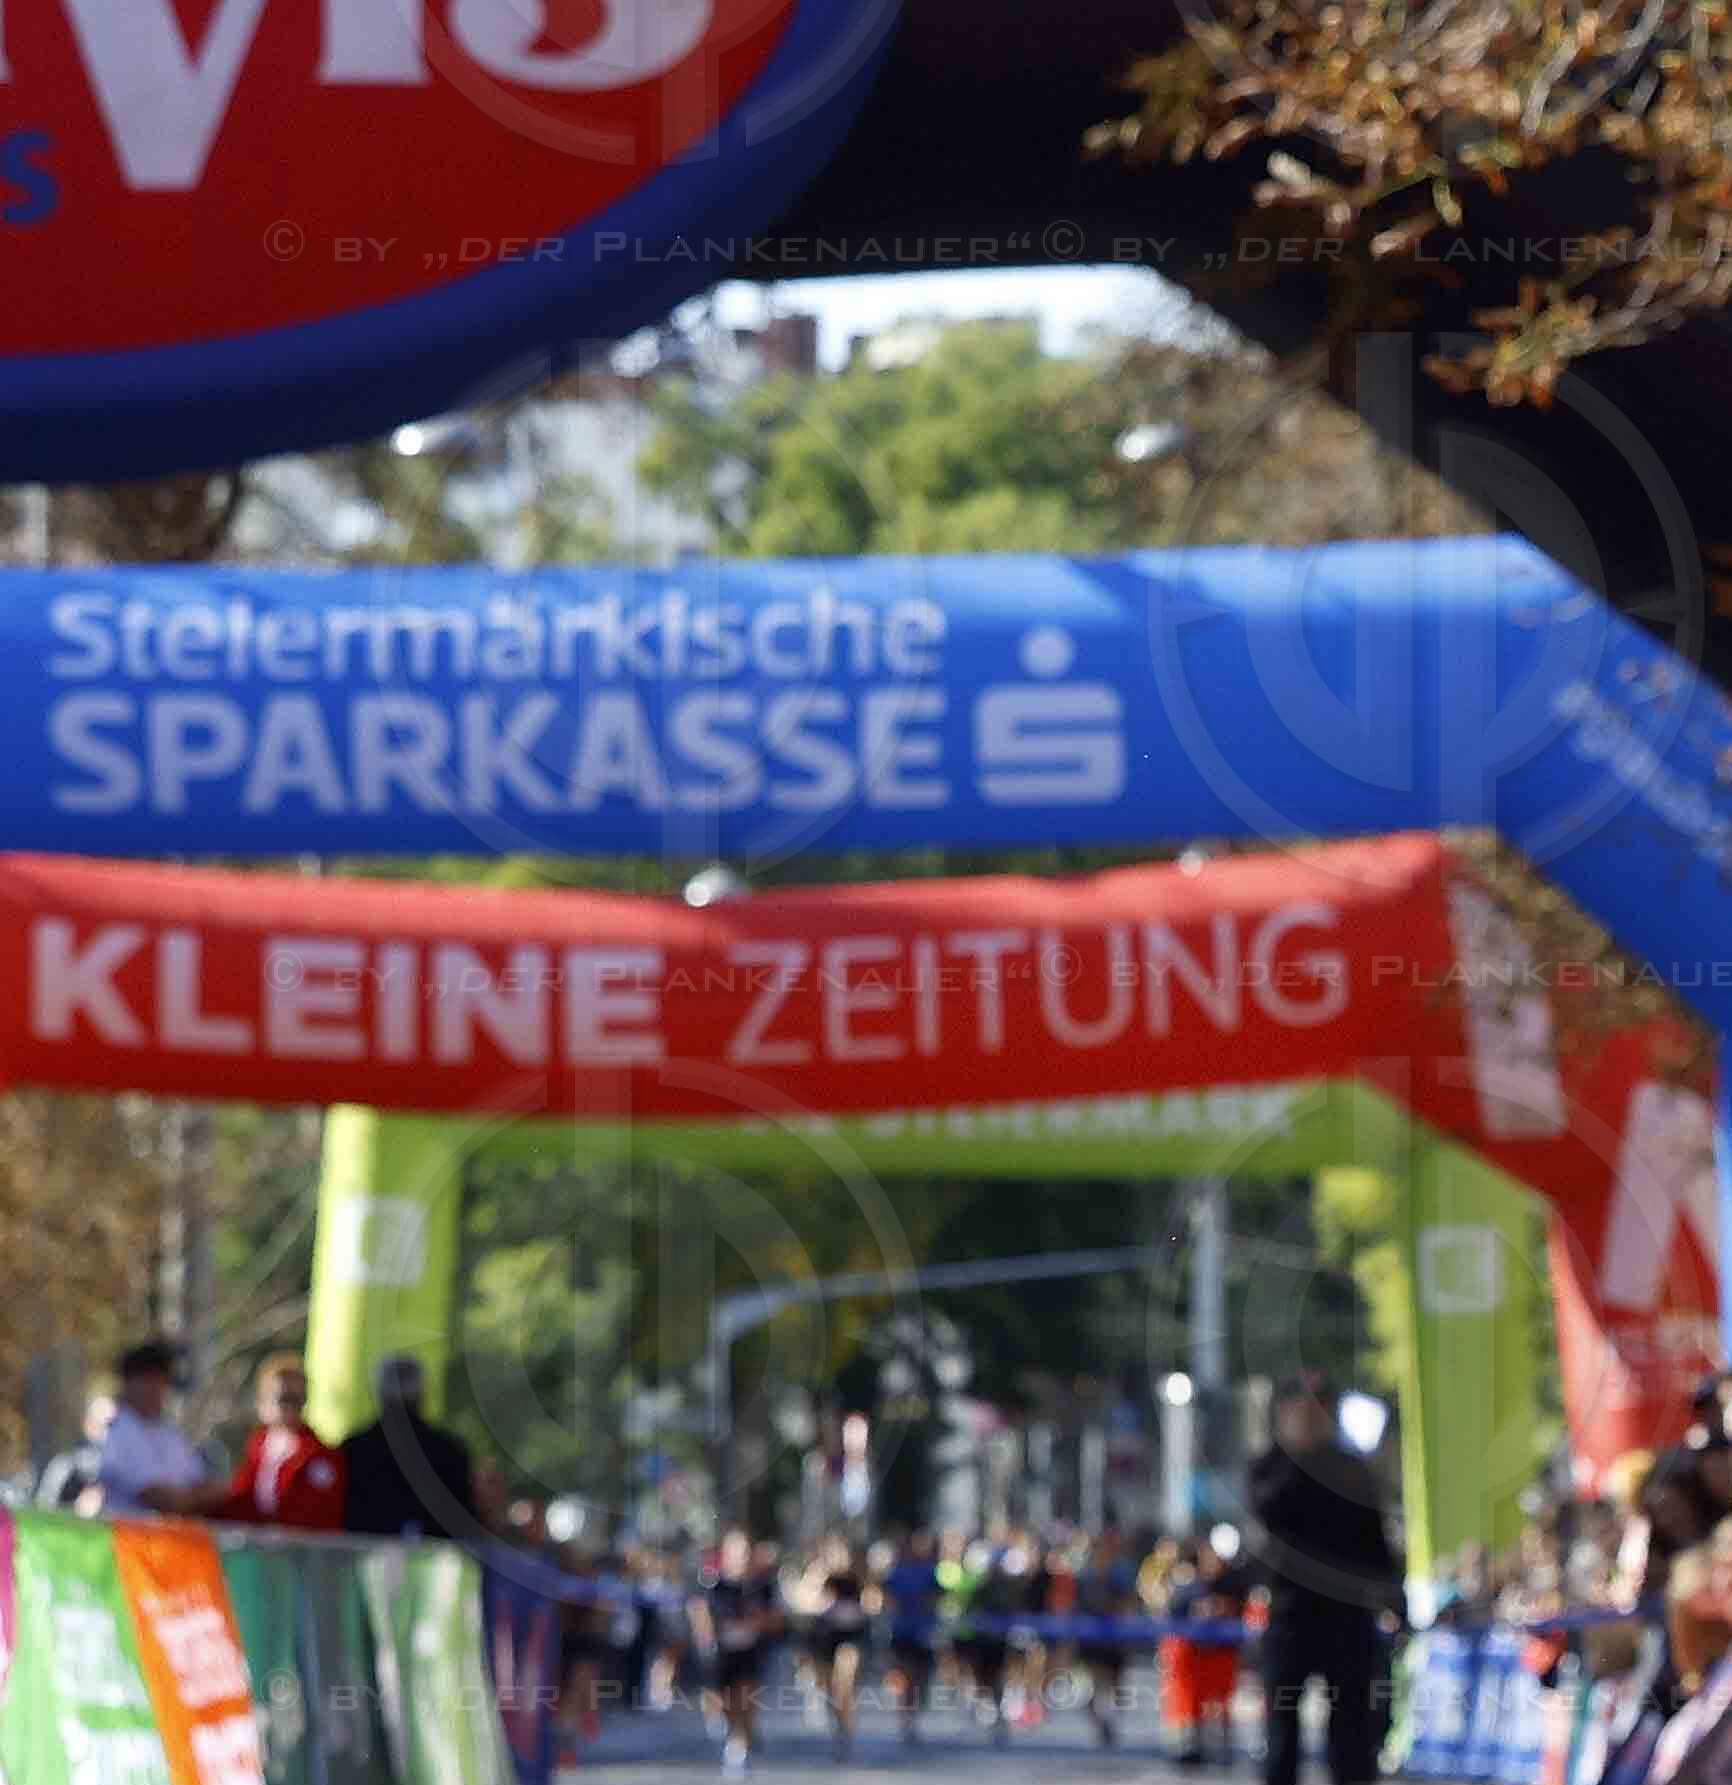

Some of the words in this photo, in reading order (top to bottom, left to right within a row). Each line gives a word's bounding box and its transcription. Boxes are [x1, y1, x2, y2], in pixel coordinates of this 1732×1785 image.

[49, 592, 946, 682] Steiermärkische
[47, 688, 950, 816] SPARKASSE
[29, 916, 666, 1068] KLEINE
[727, 903, 1351, 1065] ZEITUNG
